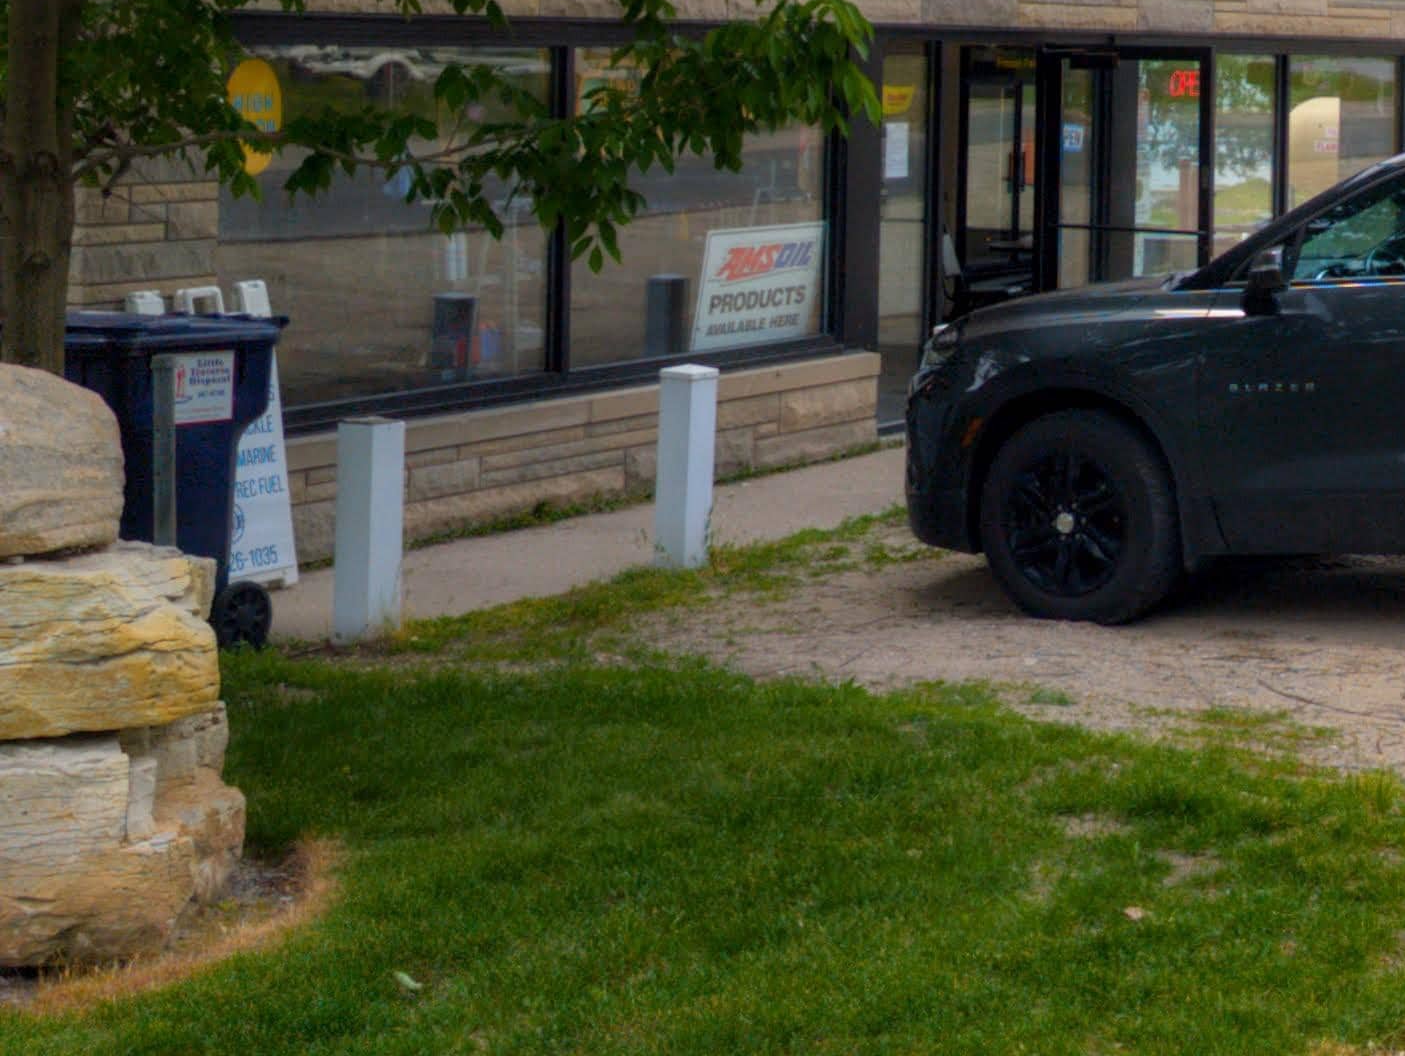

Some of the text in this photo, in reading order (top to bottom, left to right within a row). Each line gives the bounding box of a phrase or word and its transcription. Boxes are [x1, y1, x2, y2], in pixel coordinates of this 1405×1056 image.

[1168, 70, 1200, 97] OPE
[714, 241, 817, 281] AMSOIL
[709, 284, 808, 316] PRODUCTS
[705, 313, 800, 337] AVAILABLE HERE
[257, 474, 285, 495] FUEL
